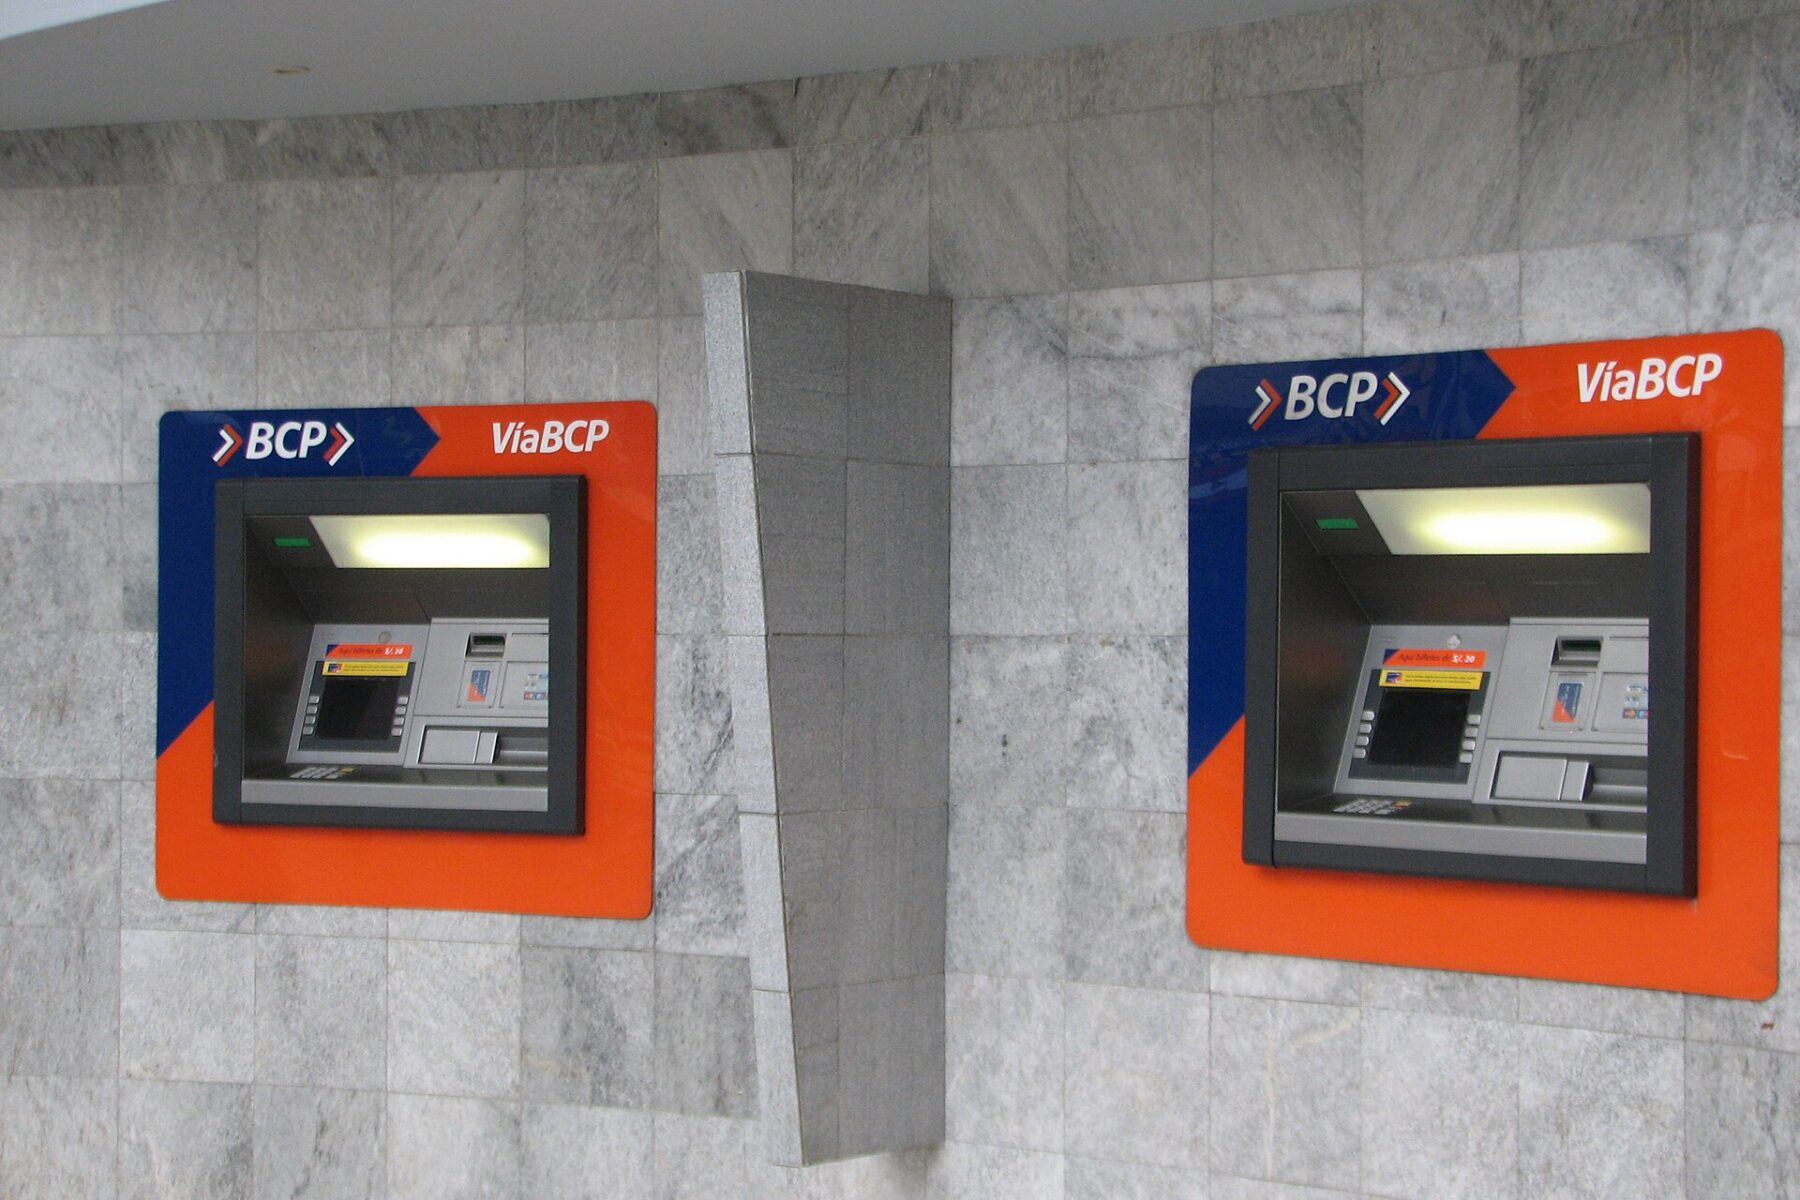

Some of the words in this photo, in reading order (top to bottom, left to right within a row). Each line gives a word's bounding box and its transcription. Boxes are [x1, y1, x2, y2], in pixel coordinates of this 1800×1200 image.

[1284, 371, 1378, 421] BCP
[1577, 352, 1723, 403] VíaBCP
[245, 420, 328, 460] BCP
[492, 419, 610, 454] VíaBCP
